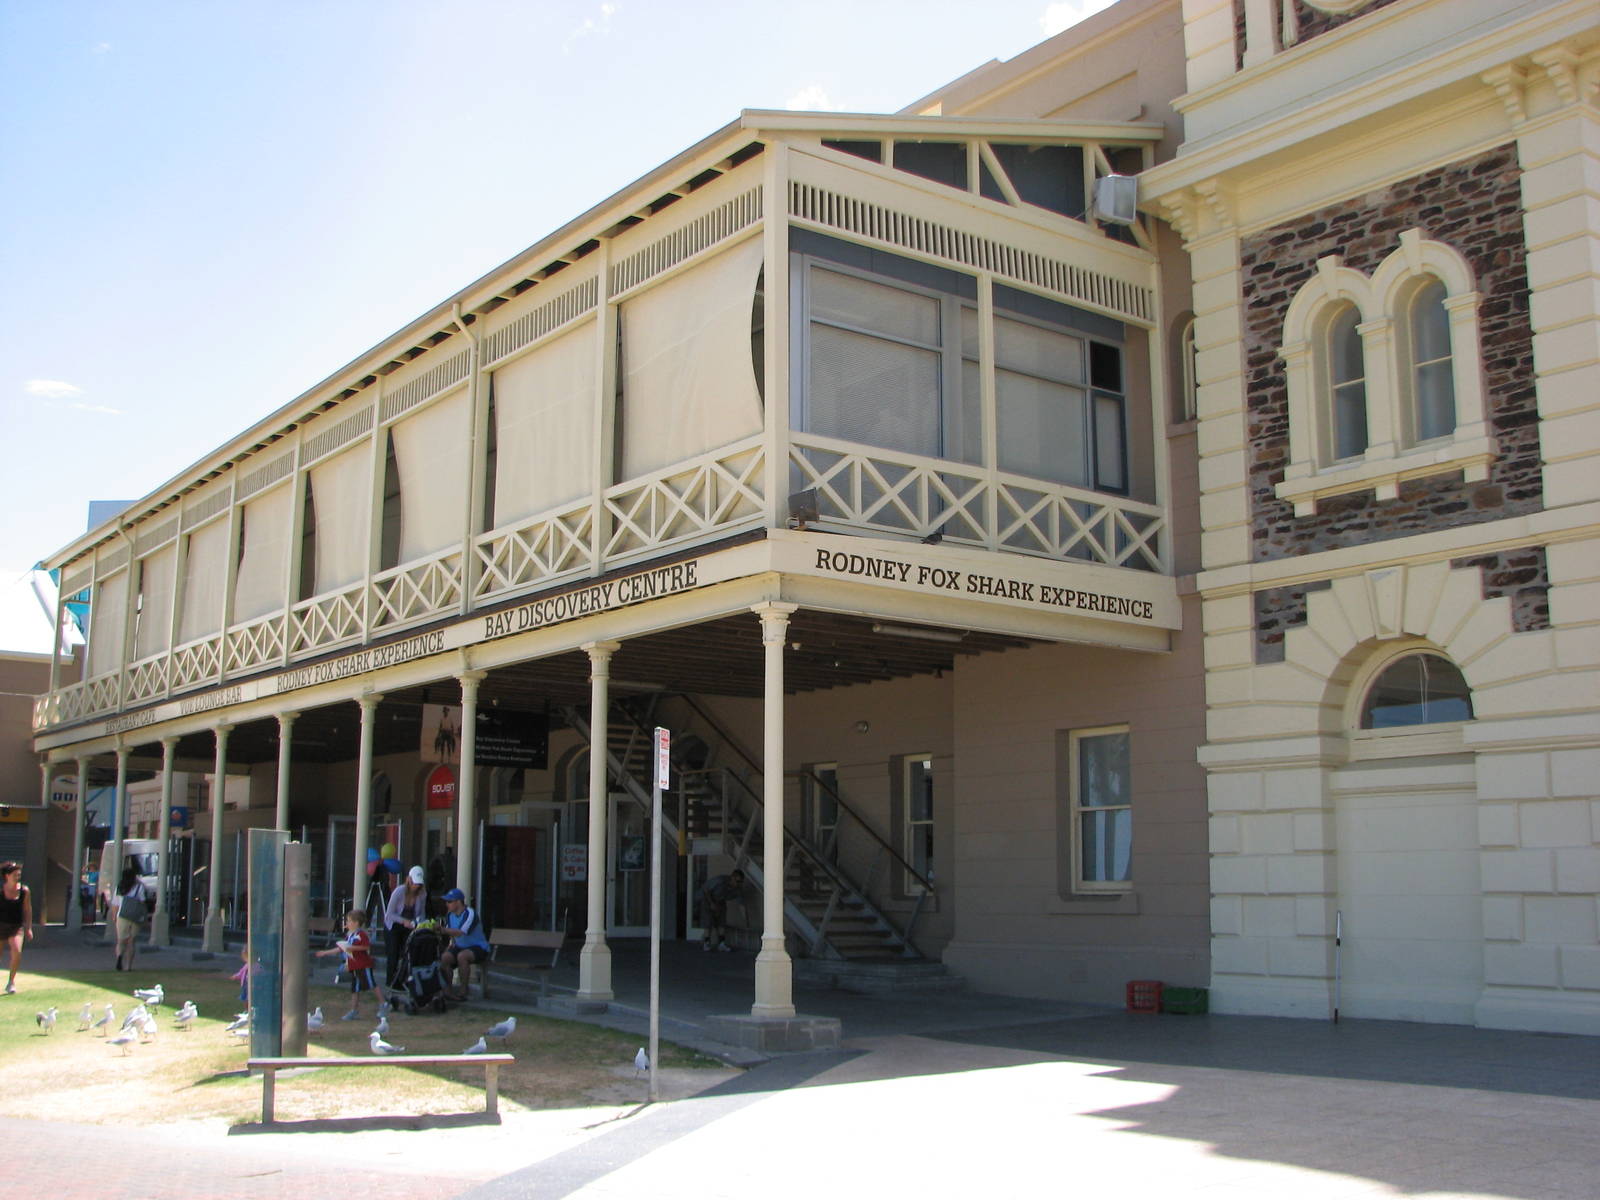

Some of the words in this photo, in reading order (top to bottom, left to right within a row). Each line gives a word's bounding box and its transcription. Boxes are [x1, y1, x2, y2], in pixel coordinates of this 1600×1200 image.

[485, 611, 515, 638] BAY
[518, 583, 615, 630] DISCOVERY
[618, 560, 698, 604] CENTRE
[815, 549, 912, 583] RODNEY
[917, 566, 961, 590] FOX
[966, 574, 1035, 601] SHARK
[1039, 585, 1153, 619] EXPERIENCE
[276, 668, 312, 692] RODNEY
[314, 662, 334, 682] FOX
[336, 651, 371, 677] SHARK
[373, 631, 445, 668] EXPERIENCE
[195, 690, 224, 711] LOUNGE
[226, 686, 242, 704] BAR
